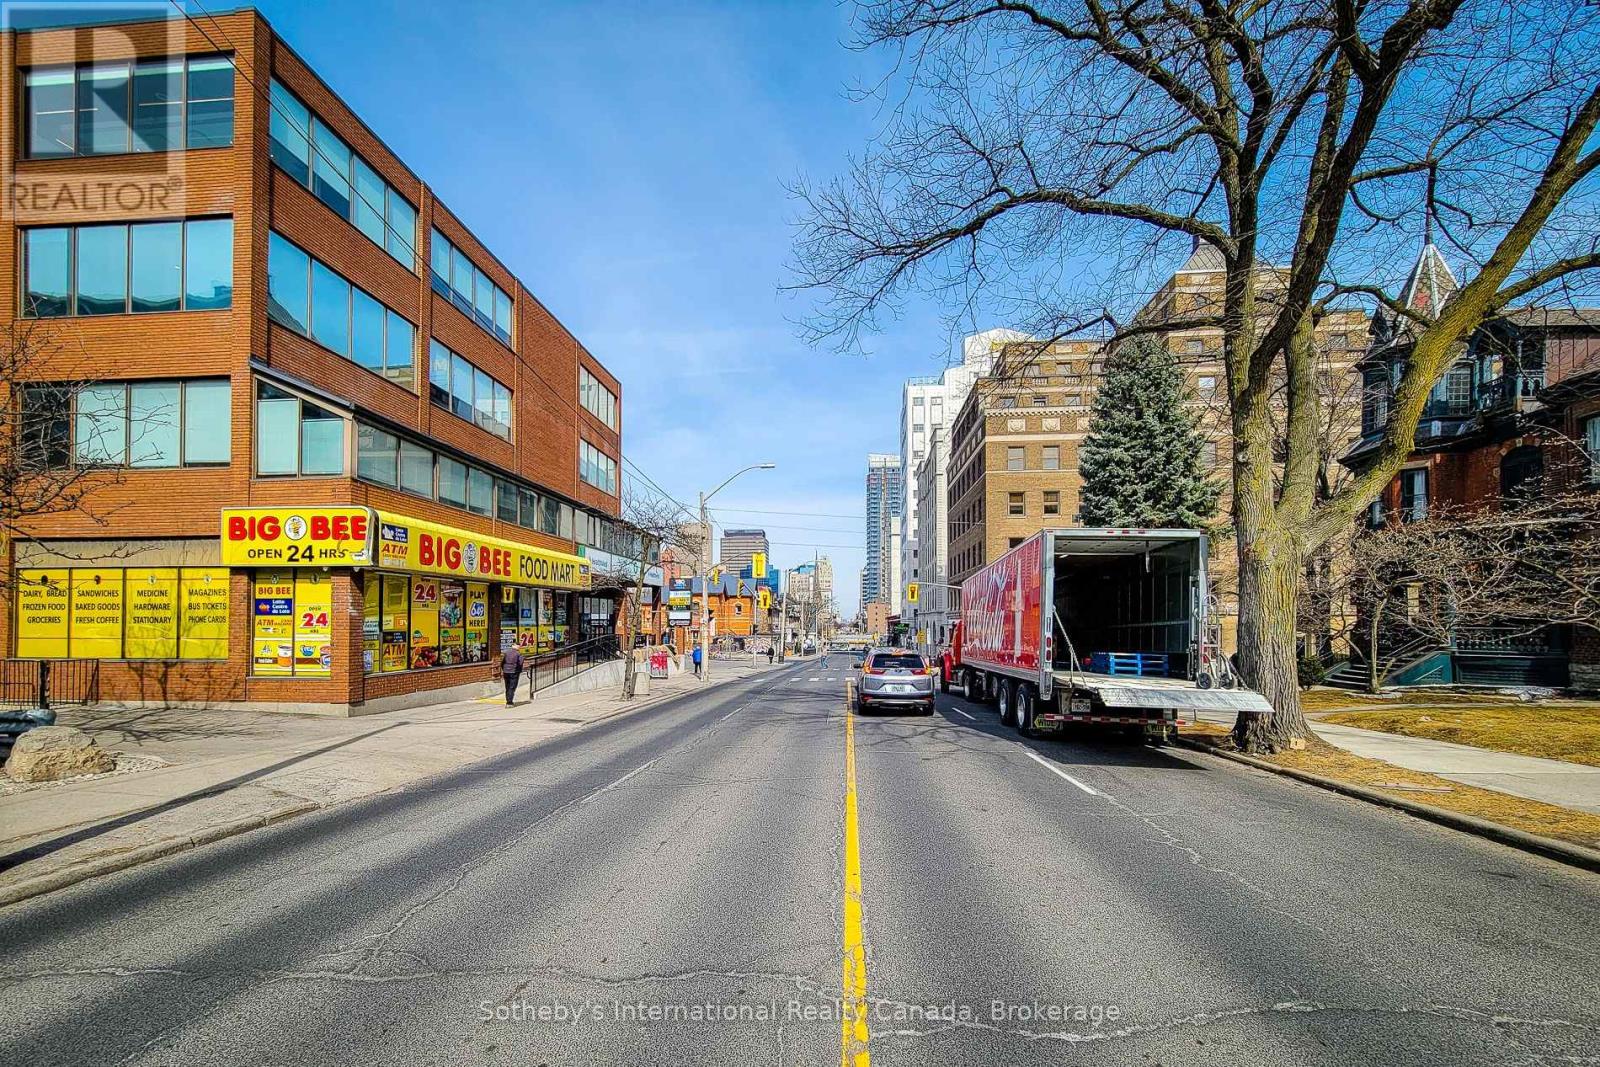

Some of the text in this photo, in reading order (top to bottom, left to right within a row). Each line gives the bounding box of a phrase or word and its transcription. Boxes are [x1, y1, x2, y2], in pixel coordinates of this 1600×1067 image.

[228, 515, 281, 541] BIG
[310, 515, 367, 541] BEE
[247, 544, 346, 563] OPEN 24 HRS
[381, 543, 408, 555] ATM
[418, 533, 462, 570] BIG
[479, 545, 512, 577] BEE
[519, 555, 548, 581] FOOD
[550, 559, 575, 584] MART
[258, 587, 291, 595] BIG BEE
[414, 584, 437, 603] 24
[469, 591, 485, 599] PLAY
[27, 616, 61, 624] GROCERIES
[75, 616, 120, 624] FRESH COFFEE
[132, 616, 172, 624] STATIONARY
[301, 612, 329, 628] 24
[520, 633, 535, 647] 24
[383, 644, 406, 657] ATM
